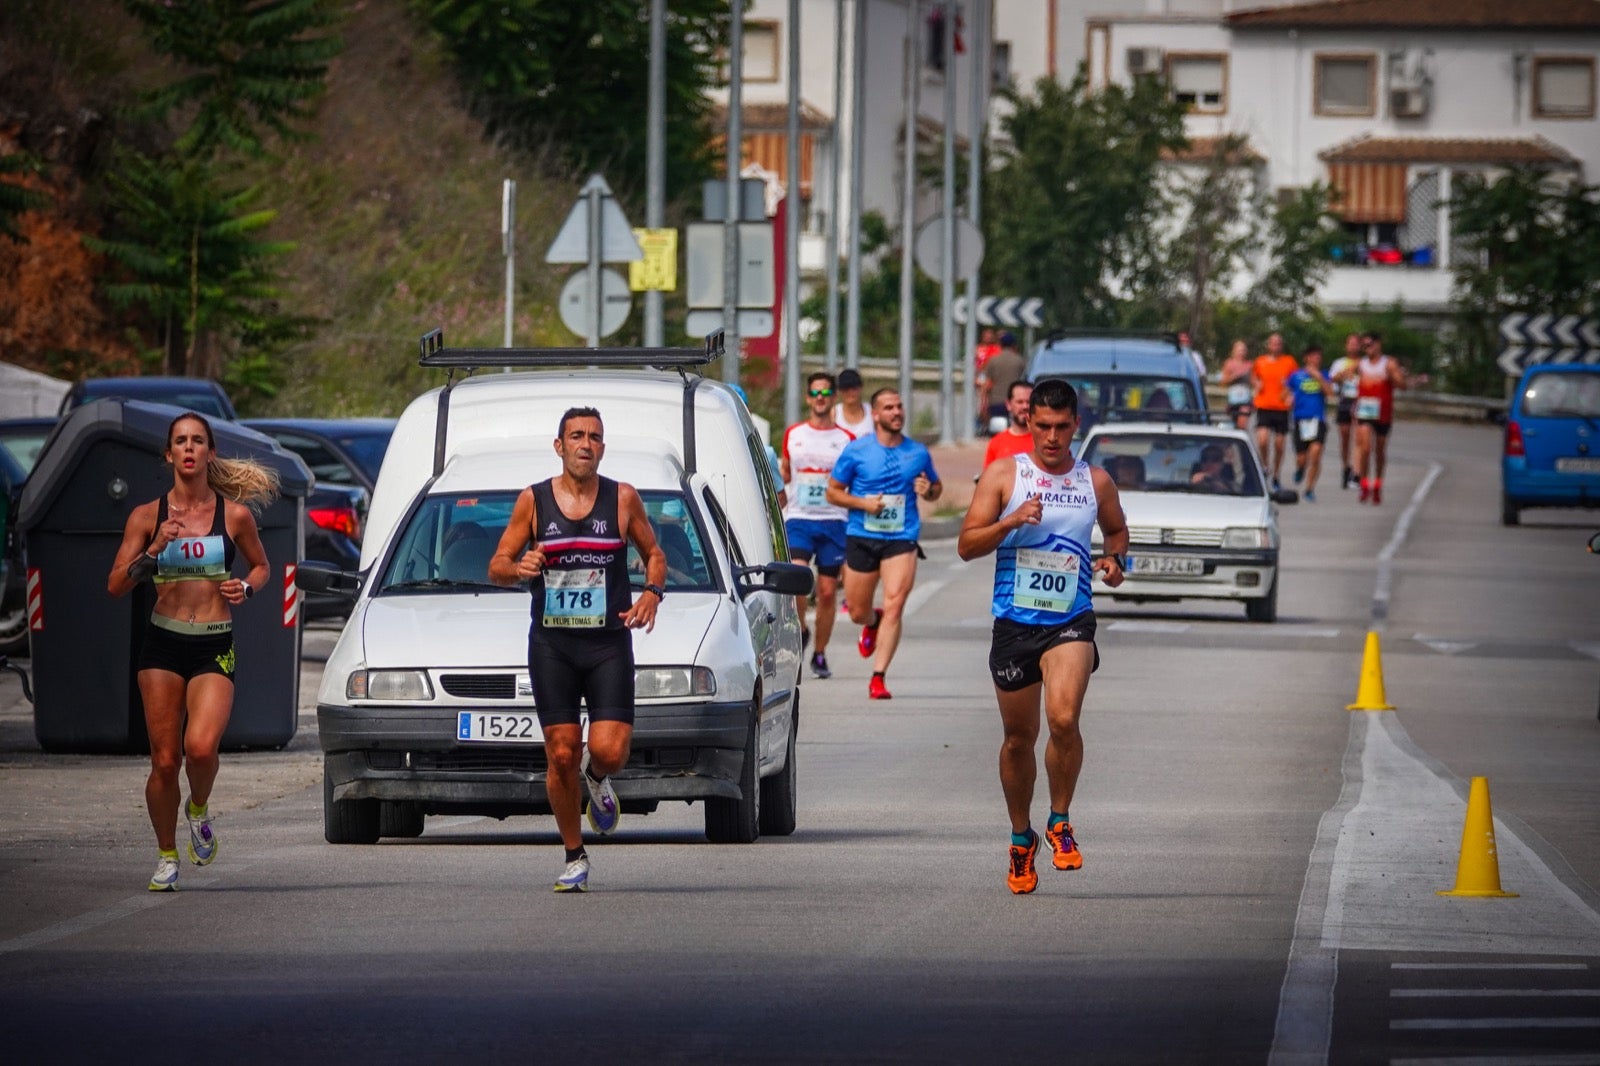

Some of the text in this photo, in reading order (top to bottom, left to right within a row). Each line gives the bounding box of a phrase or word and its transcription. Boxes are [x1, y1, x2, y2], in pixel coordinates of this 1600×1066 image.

[809, 486, 827, 496] 22
[181, 542, 204, 559] 10
[1029, 572, 1066, 593] 200
[556, 592, 592, 608] 178
[1034, 599, 1052, 608] ERWIN
[479, 716, 532, 738] 1522
